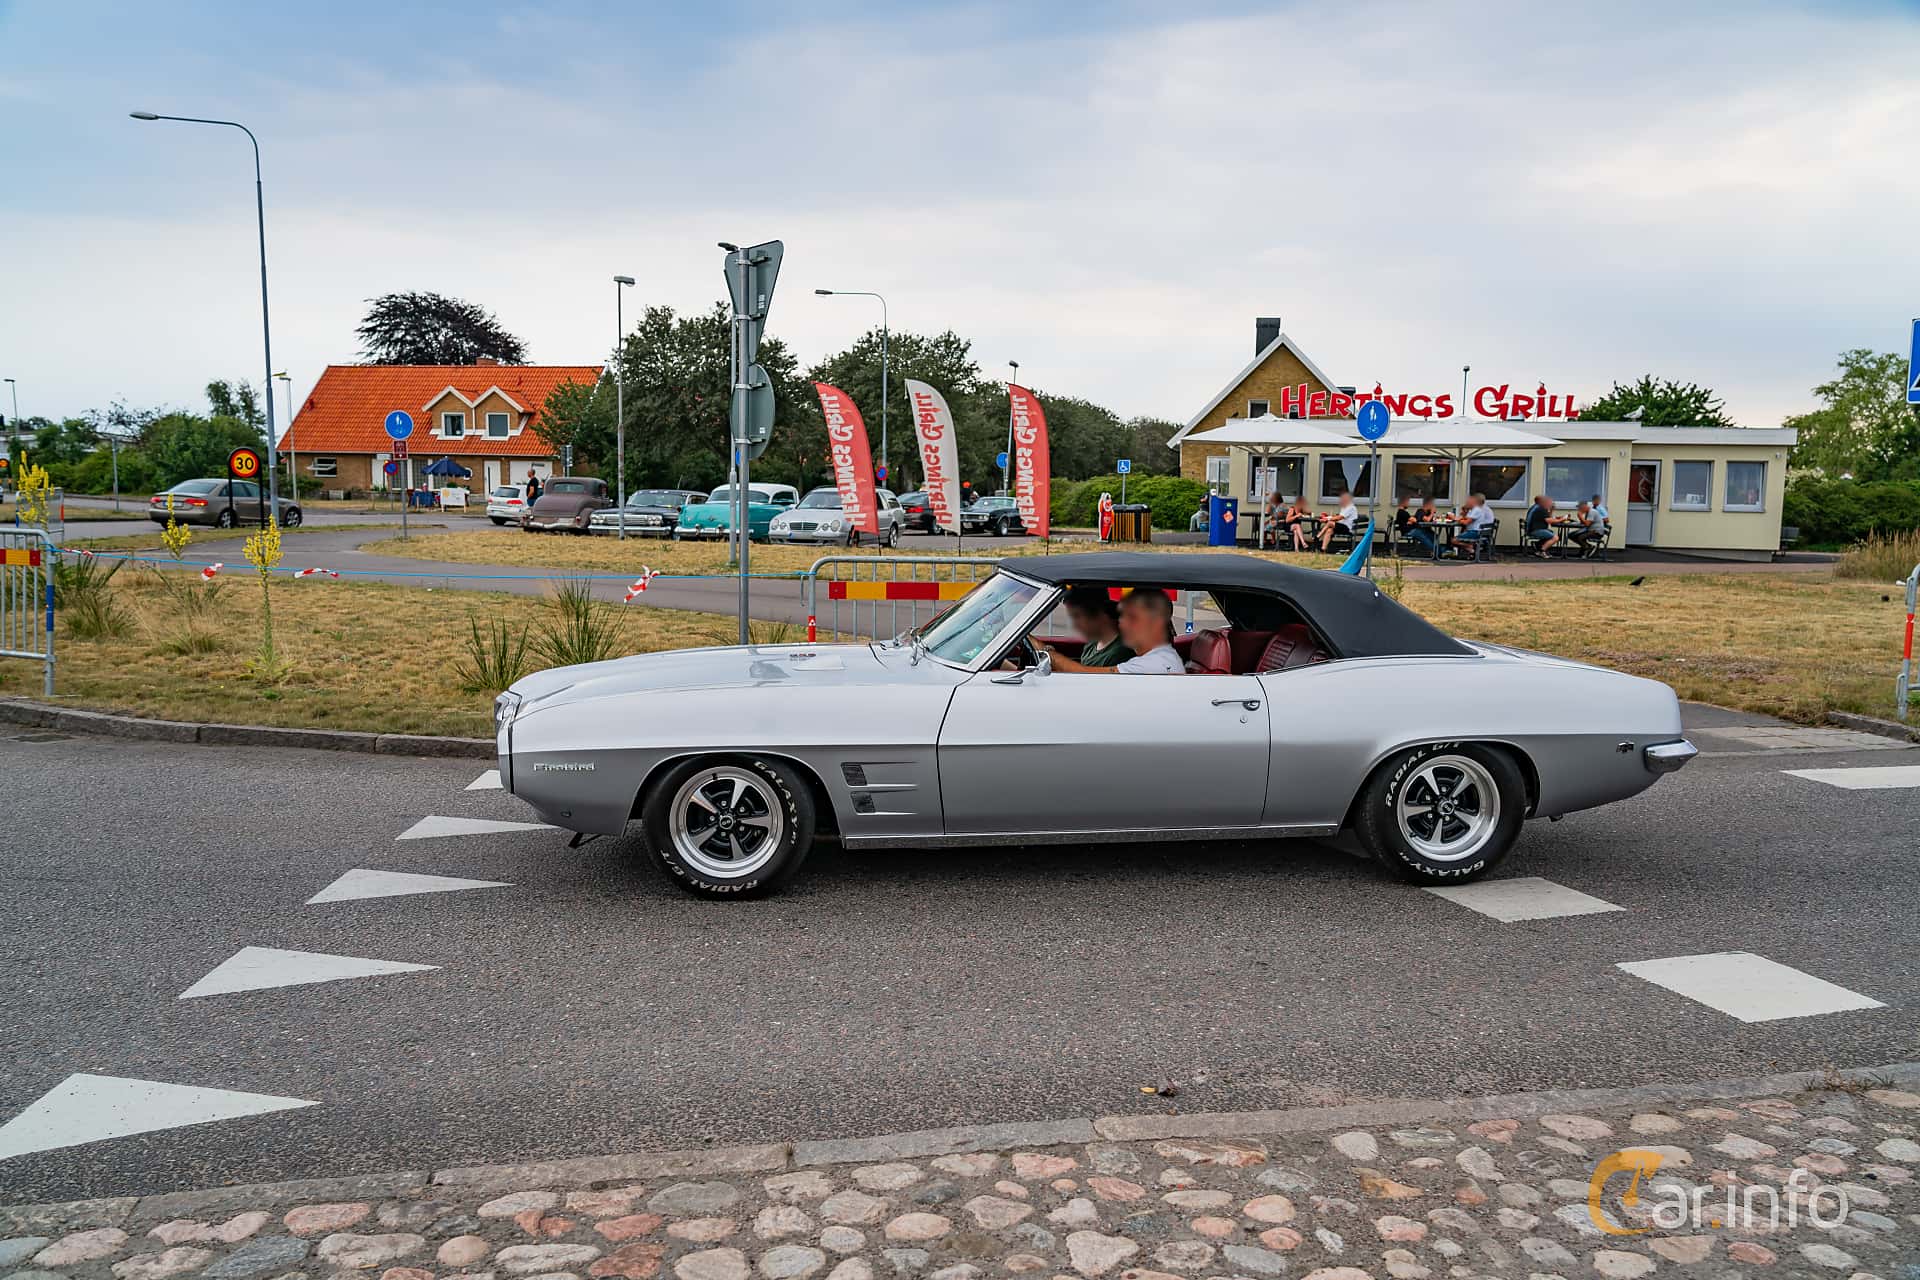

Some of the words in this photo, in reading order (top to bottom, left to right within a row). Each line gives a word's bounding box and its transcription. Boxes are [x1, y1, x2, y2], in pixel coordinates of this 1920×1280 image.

[236, 457, 254, 470] 30
[533, 763, 595, 771] Firebird
[1385, 750, 1426, 807] RADIAL
[753, 761, 798, 828] GALAXY
[690, 879, 760, 893] RADIAL
